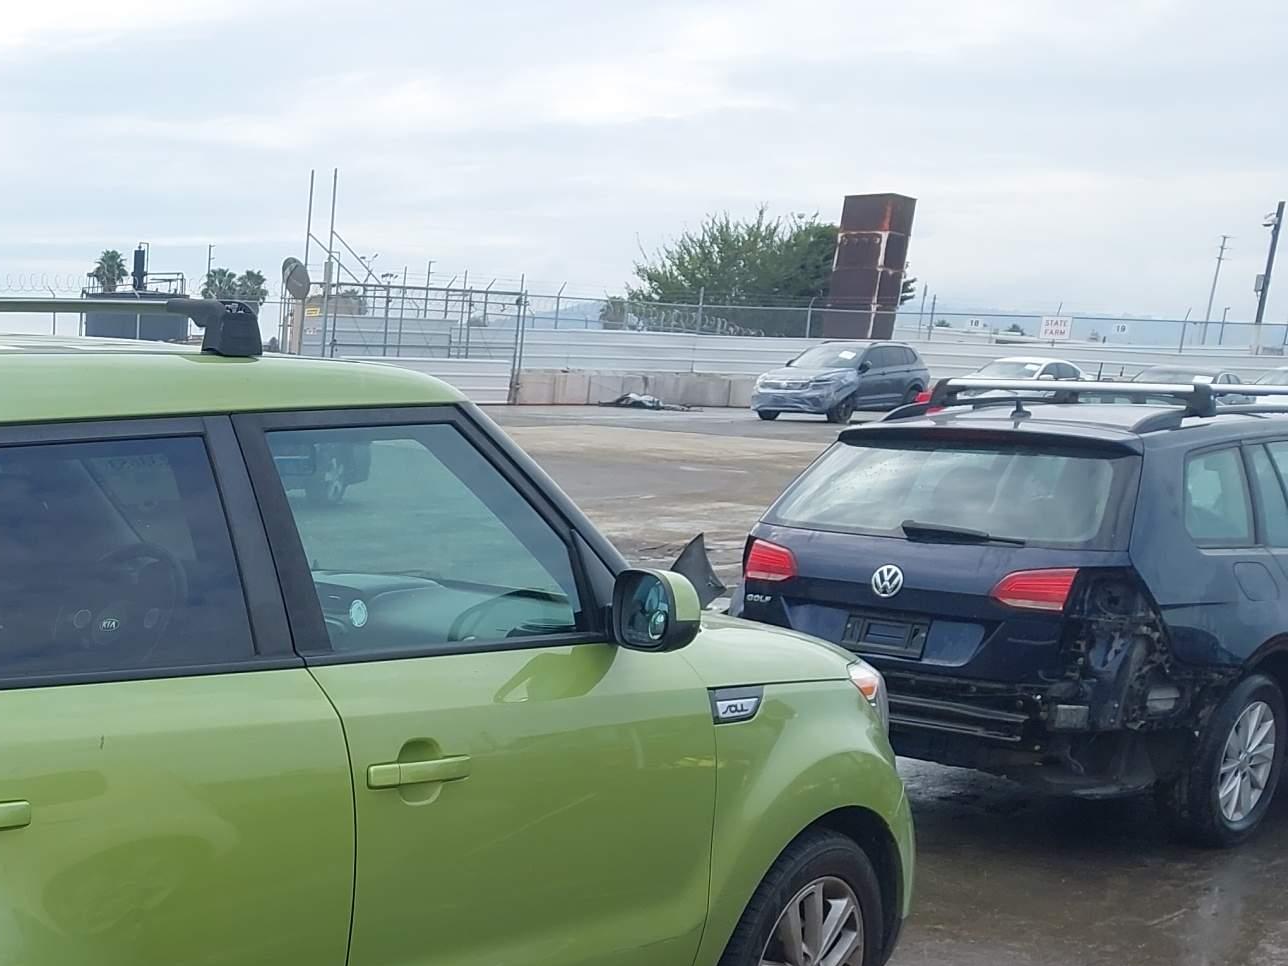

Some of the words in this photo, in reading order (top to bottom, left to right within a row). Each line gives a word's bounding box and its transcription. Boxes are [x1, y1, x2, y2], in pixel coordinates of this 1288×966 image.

[1044, 319, 1069, 327] STATE
[1043, 328, 1066, 336] FARM
[746, 593, 772, 603] GOLF
